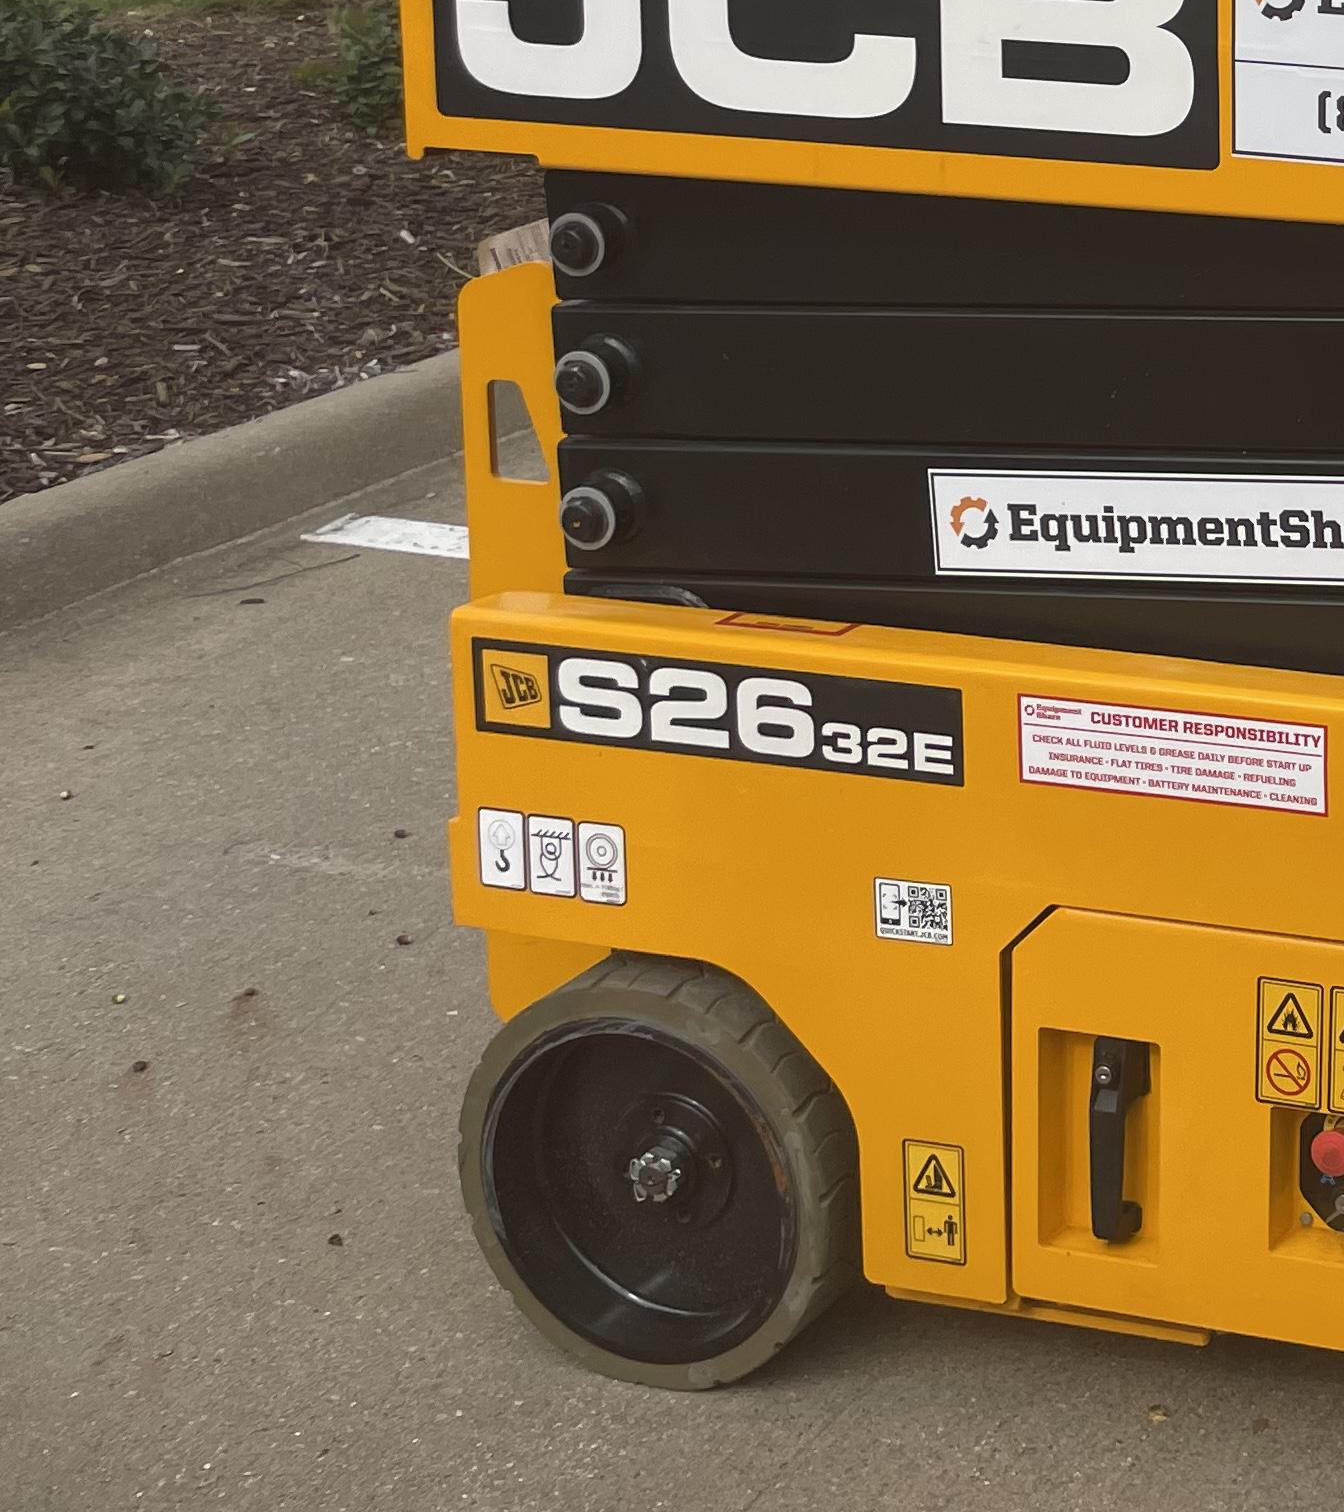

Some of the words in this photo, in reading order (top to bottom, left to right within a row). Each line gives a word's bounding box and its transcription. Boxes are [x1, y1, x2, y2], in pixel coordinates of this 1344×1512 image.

[499, 671, 538, 705] JCB
[1090, 711, 1179, 733] CUSTOMER
[1183, 721, 1321, 748] RESPONSIBILITY
[1032, 734, 1063, 745] CHECK
[1066, 736, 1082, 747] ALL
[1084, 739, 1112, 750] FLUID
[1114, 743, 1147, 754] LEVELS
[1159, 747, 1195, 760] GREASE
[1198, 752, 1226, 764] DAILY
[1228, 755, 1264, 767] BEFORE
[1266, 759, 1297, 772] START
[1299, 763, 1312, 772] UP
[1048, 751, 1103, 766] INSURANCE
[1110, 758, 1132, 769] FLAT
[1135, 761, 1163, 773] TIRES
[1171, 765, 1193, 776] TIRE
[1195, 767, 1235, 780] DAMAGE
[1243, 773, 1296, 787] REFUELING
[1028, 765, 1068, 778] DAMAGE
[1070, 769, 1082, 780] TO
[1085, 771, 1141, 786] EQUIPMENT
[1148, 778, 1190, 792] BATTERY
[1192, 783, 1262, 800] MAINTENANCE
[1269, 792, 1317, 806] CLEANING
